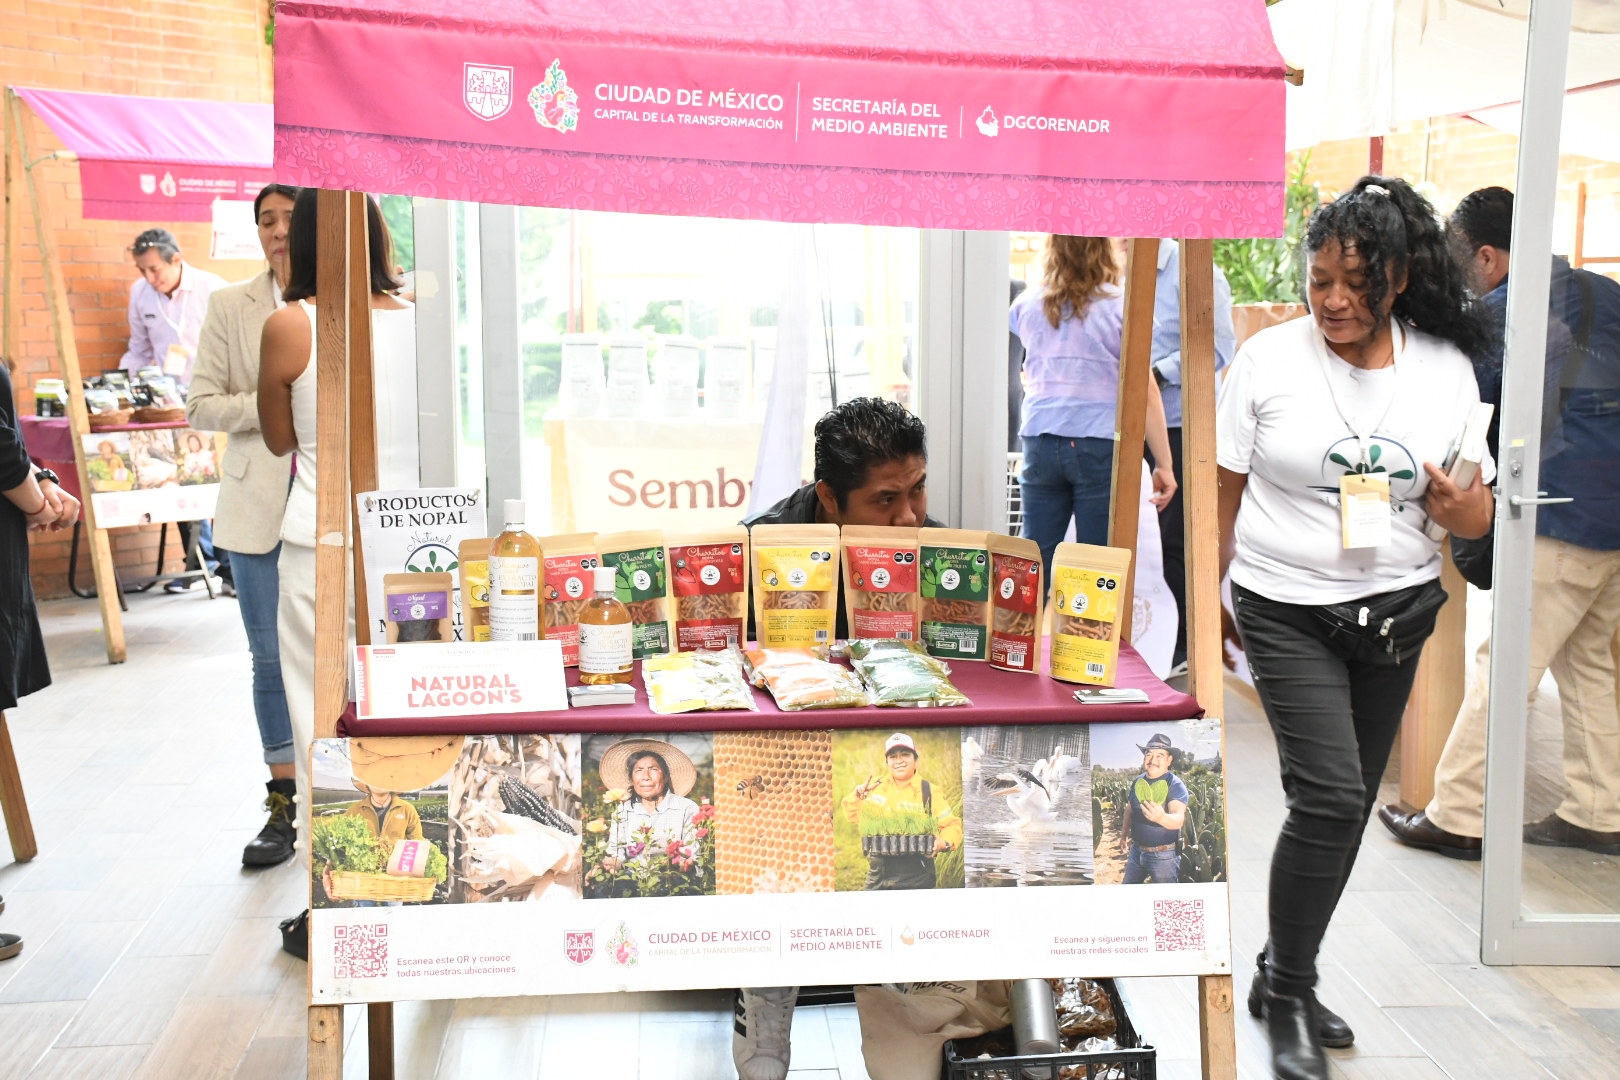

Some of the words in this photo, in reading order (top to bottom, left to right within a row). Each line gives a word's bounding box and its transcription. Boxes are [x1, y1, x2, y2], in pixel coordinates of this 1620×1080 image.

[594, 83, 672, 105] CIUDAD
[676, 88, 702, 107] DE
[707, 87, 784, 111] MÉXICO
[812, 96, 907, 116] SECRETARÍA
[911, 103, 941, 118] DEL
[594, 108, 640, 122] CAPITAL
[642, 112, 658, 123] DE
[660, 113, 675, 124] LA
[677, 113, 783, 130] TRANSFORMACIÓN
[1003, 115, 1110, 133] DGCORENADR
[811, 117, 865, 134] MEDIO
[868, 121, 948, 139] AMBIENTE
[380, 514, 404, 528] DE
[408, 511, 468, 527] NOPAL
[407, 530, 452, 552] Natural
[687, 547, 726, 558] Churritos
[856, 547, 891, 558] Churritos
[936, 549, 971, 560] Churritos
[410, 673, 517, 692] NATURAL
[407, 688, 523, 708] LAGOON'S
[648, 932, 698, 944] CIUDAD
[701, 931, 718, 943] DE
[721, 928, 771, 942] MÉXICO
[790, 926, 854, 938] SECRETARÍA
[856, 927, 877, 936] DEL
[918, 929, 990, 940] DGCORENADR
[790, 941, 826, 951] MEDIO
[828, 939, 883, 951] AMBIENTE
[1054, 936, 1088, 944] Escanea
[648, 948, 678, 957] CAPITAL
[679, 948, 690, 956] DE
[691, 947, 701, 955] LA
[1050, 947, 1086, 955] nuestras
[1088, 946, 1112, 954] redes
[1114, 945, 1149, 954] sociales
[397, 957, 433, 966] Escanea
[456, 955, 470, 964] QR
[471, 956, 477, 964] y
[396, 969, 421, 978] todas
[423, 968, 462, 976] nuestras
[464, 965, 517, 975] ubicaciones
